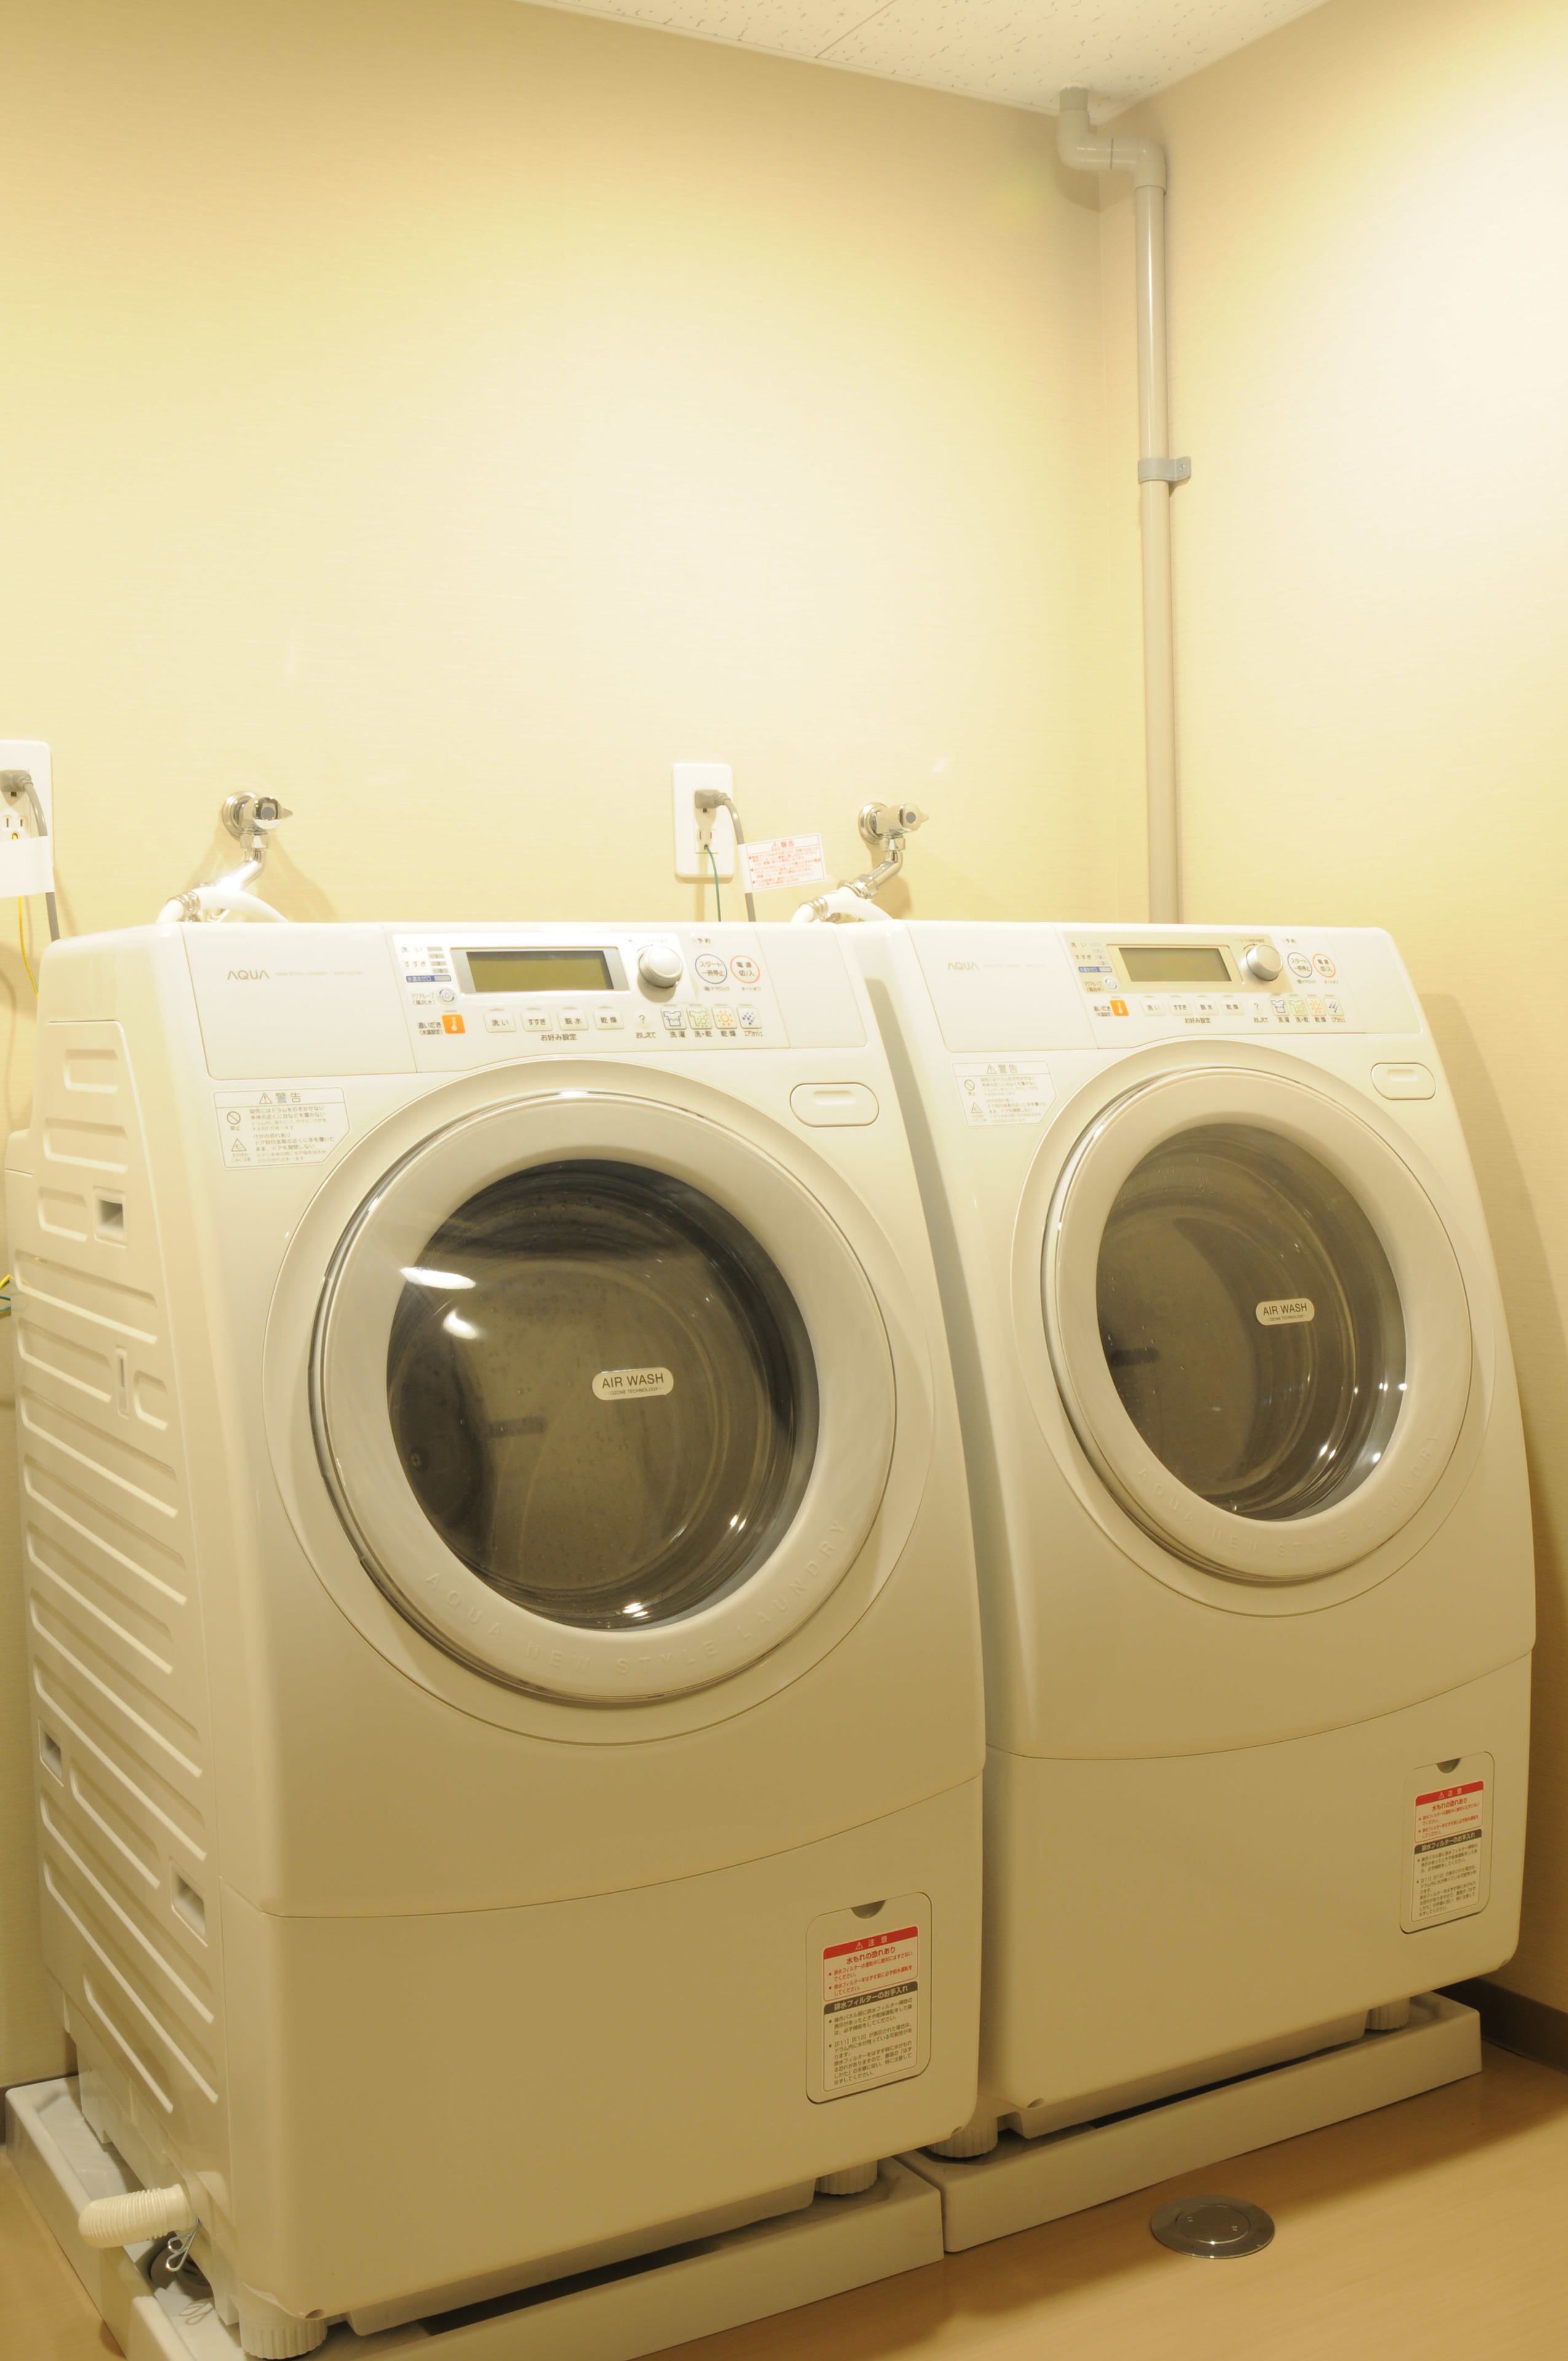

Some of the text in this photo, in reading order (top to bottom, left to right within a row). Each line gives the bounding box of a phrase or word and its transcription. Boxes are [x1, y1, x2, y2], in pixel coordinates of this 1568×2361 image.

[948, 961, 980, 970] AQUA
[226, 970, 270, 981] AQUA
[275, 1093, 302, 1104] 警告
[1263, 1302, 1307, 1316] AIR WASH
[602, 1372, 664, 1388] AIR WASH
[426, 1519, 848, 1675] AQUA NEW STYLE LAUNDRY
[868, 1936, 887, 1947] 注意
[846, 1947, 896, 1964] 水もれの恐れあり
[834, 1985, 908, 2011] 排水フィルターのお手入れ
